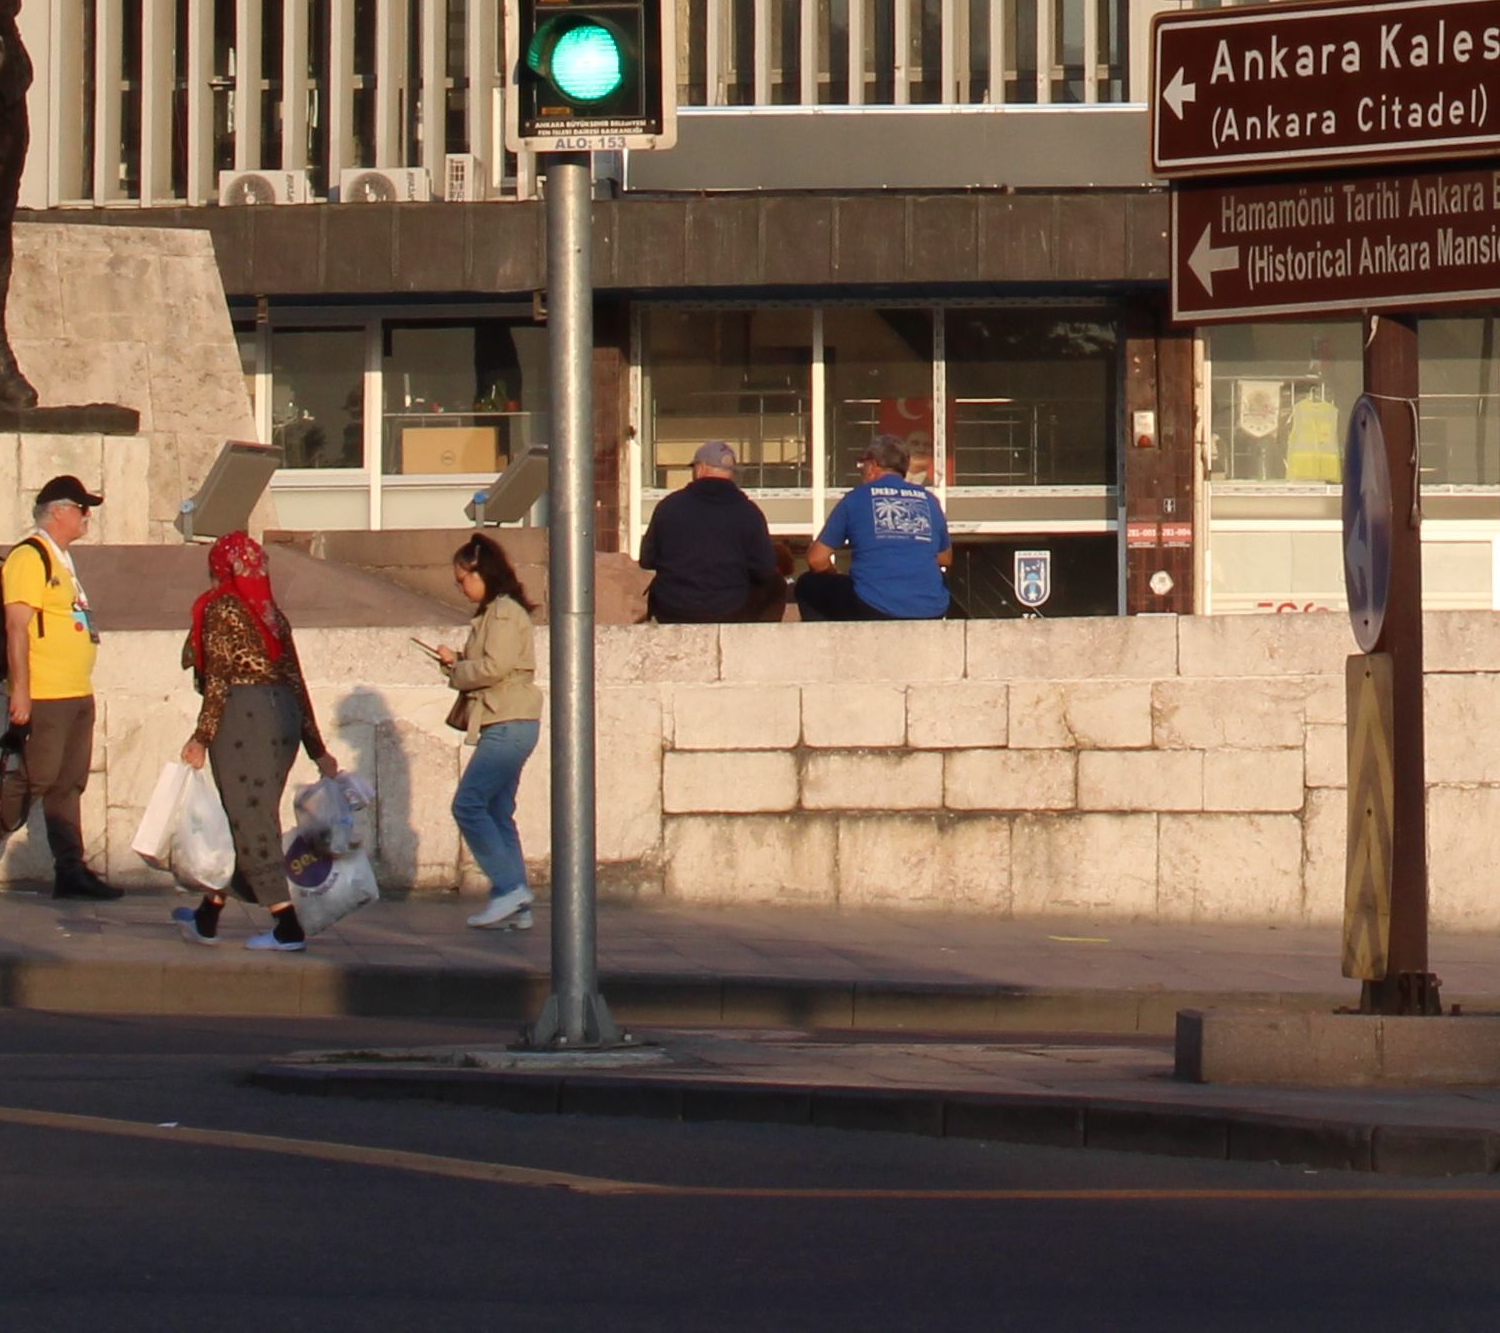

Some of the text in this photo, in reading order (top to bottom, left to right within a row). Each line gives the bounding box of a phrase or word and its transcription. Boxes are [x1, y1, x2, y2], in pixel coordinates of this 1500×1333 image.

[1209, 37, 1361, 85] Ankara
[555, 137, 627, 150] ALO: 153
[1211, 83, 1488, 149] (Ankara Citadel)
[1221, 183, 1335, 234] Hamamönü
[1344, 180, 1400, 221] Tarihi
[1408, 174, 1485, 218] Ankara
[1247, 233, 1353, 289] (Historical
[1359, 229, 1431, 273] Ankara
